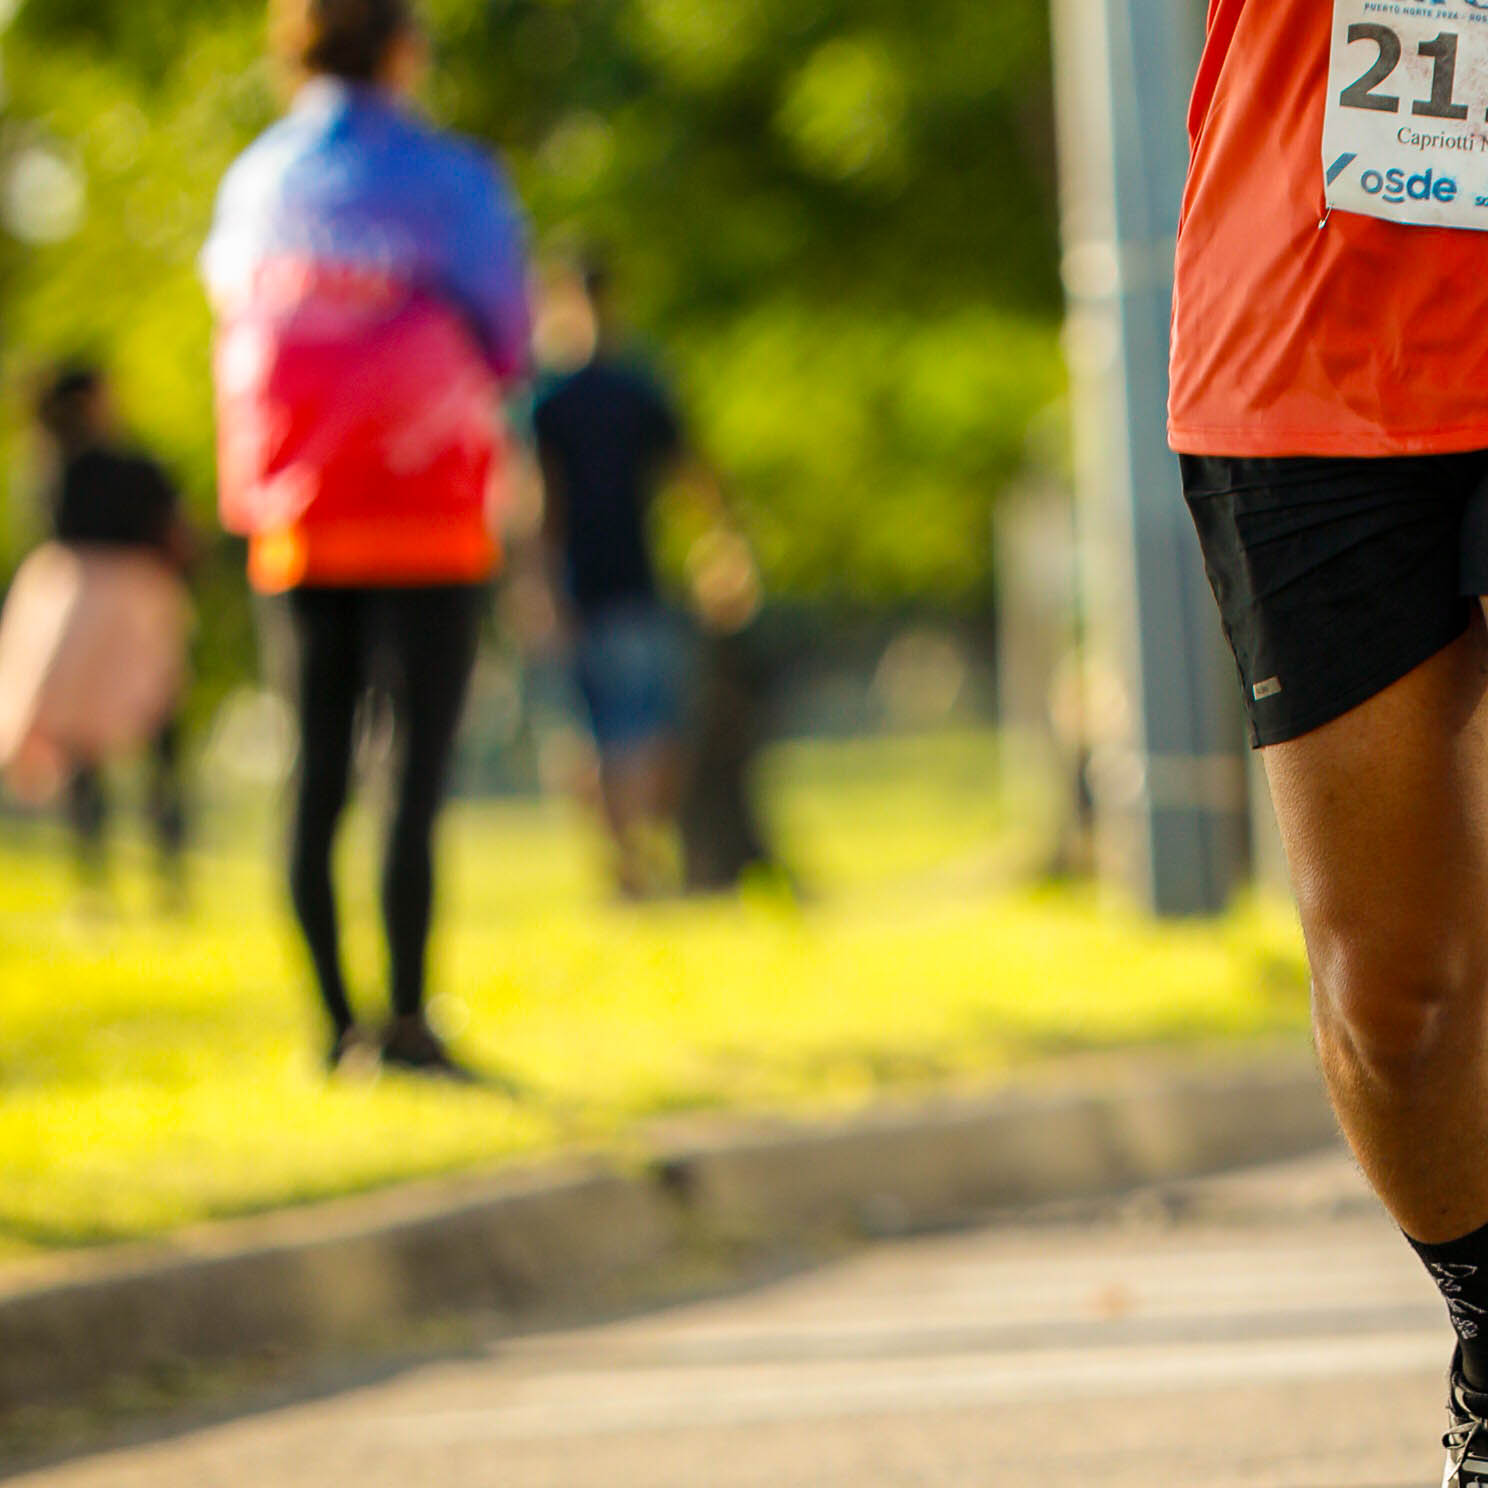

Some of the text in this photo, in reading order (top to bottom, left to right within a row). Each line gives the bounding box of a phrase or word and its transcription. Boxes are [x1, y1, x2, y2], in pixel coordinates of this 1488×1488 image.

[1364, 1, 1400, 13] PUERTO
[1403, 7, 1432, 17] NORTE
[1397, 126, 1474, 152] Capriotti
[1360, 168, 1457, 202] osde
